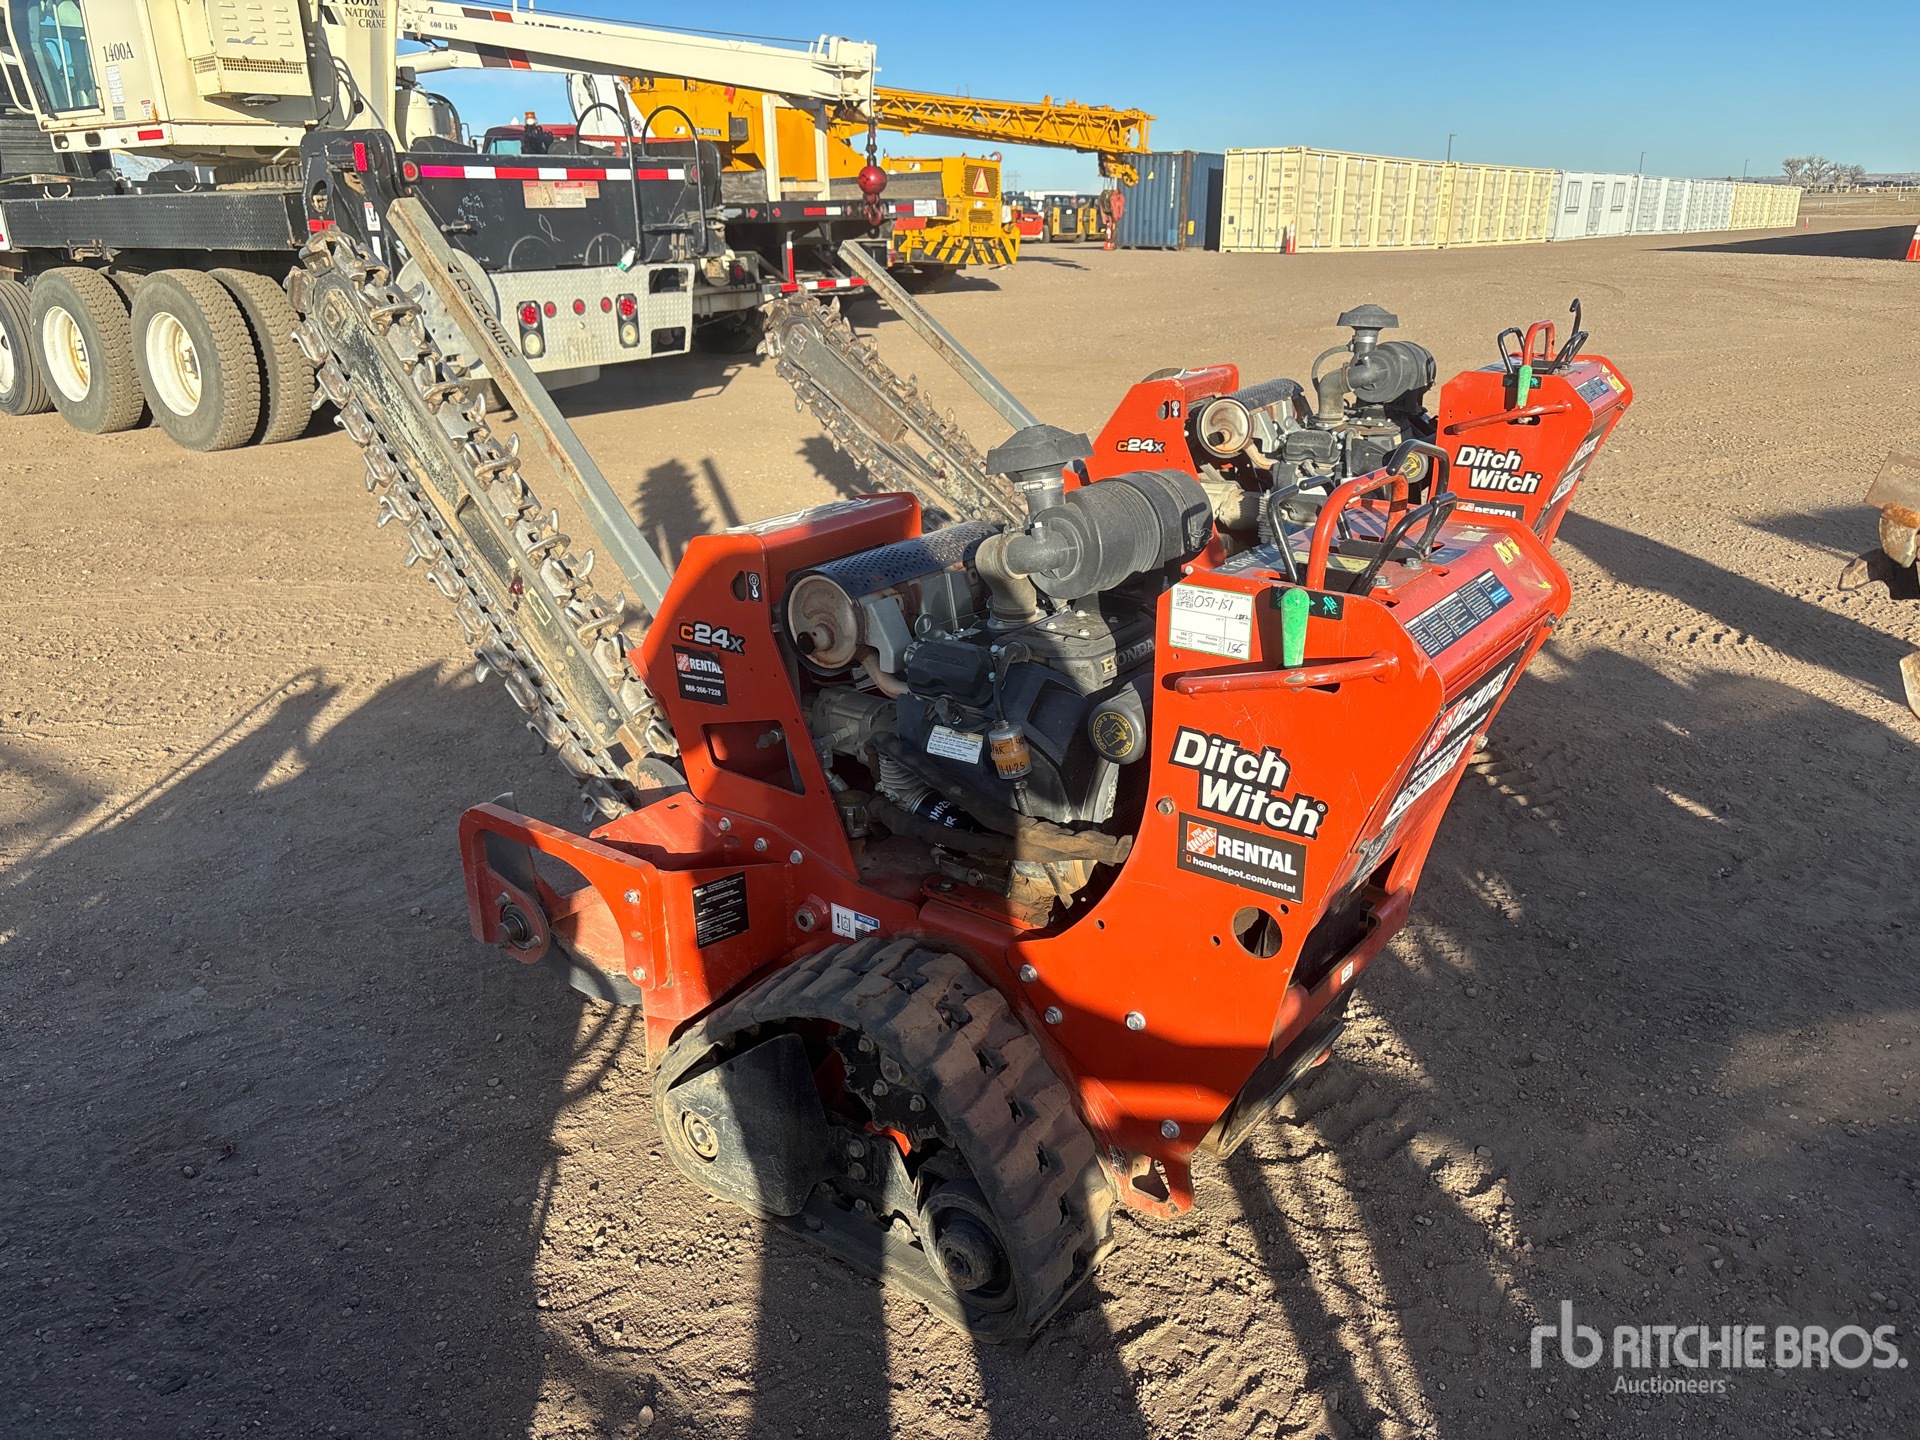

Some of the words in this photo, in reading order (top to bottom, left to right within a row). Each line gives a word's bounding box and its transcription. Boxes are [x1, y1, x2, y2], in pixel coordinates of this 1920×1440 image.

[345, 7, 386, 18] NATIONAL
[358, 19, 386, 28] CRANE
[445, 22, 458, 31] LBS
[103, 41, 135, 62] 1400A
[1455, 446, 1522, 470] Ditch
[1470, 468, 1540, 493] Witch
[689, 657, 724, 675] RENTAL
[1101, 638, 1155, 675] HONDA
[1447, 663, 1515, 736] RENTAL
[1173, 730, 1288, 789] Ditch
[1201, 773, 1321, 836] Witch
[1188, 828, 1216, 851] HOME
[1217, 834, 1298, 877] RENTAL
[1192, 856, 1296, 894] homedepot.com/rental
